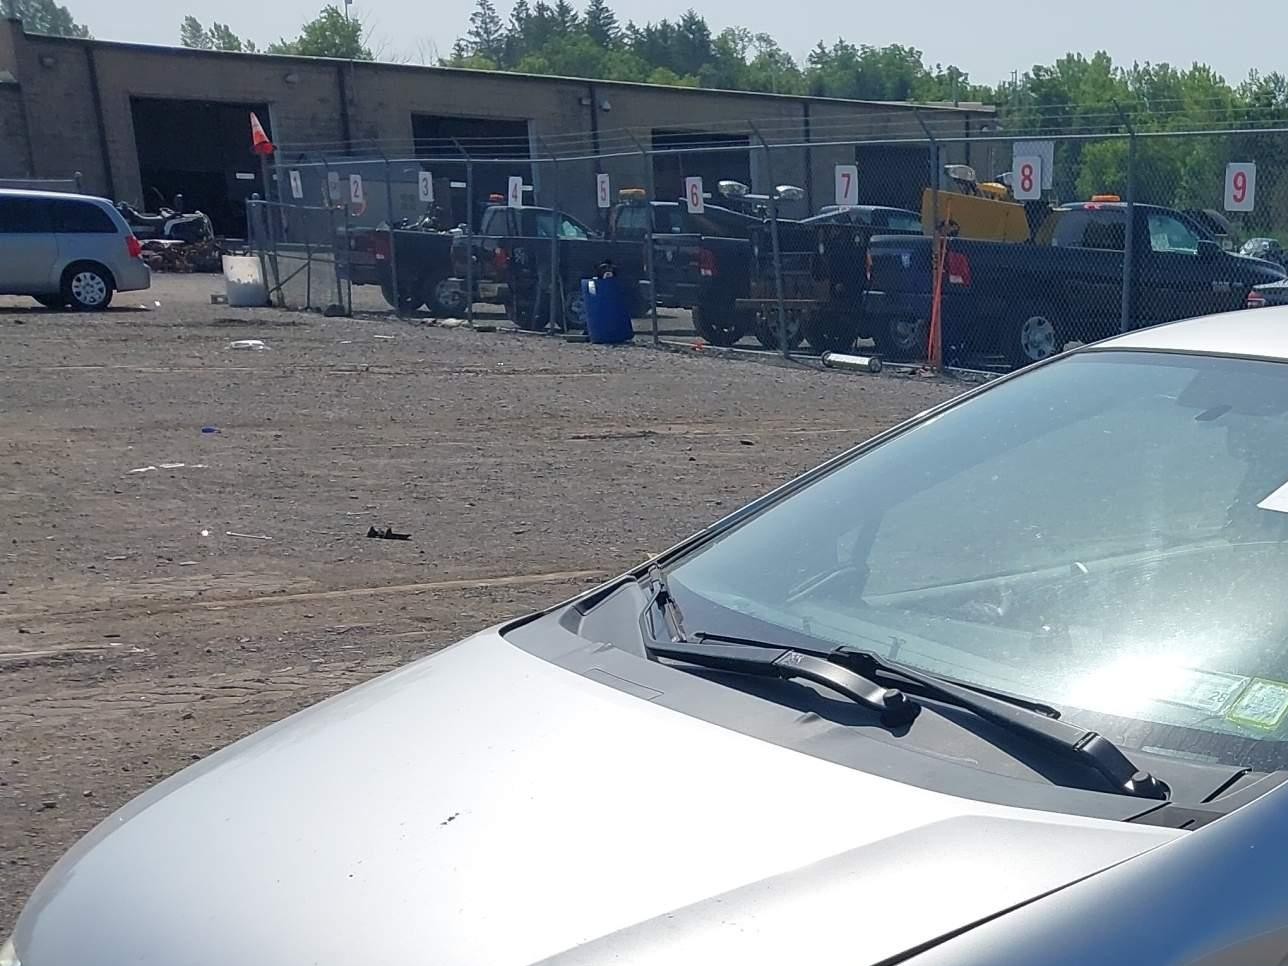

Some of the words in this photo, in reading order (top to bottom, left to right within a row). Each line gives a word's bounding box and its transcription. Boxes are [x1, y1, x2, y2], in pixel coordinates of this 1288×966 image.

[352, 180, 359, 198] 2
[423, 177, 429, 196] 3
[841, 173, 851, 198] 7
[1021, 164, 1033, 192] 8
[1232, 171, 1247, 203] 9
[511, 183, 518, 203] 4
[600, 181, 607, 201] 5
[690, 183, 699, 207] 6
